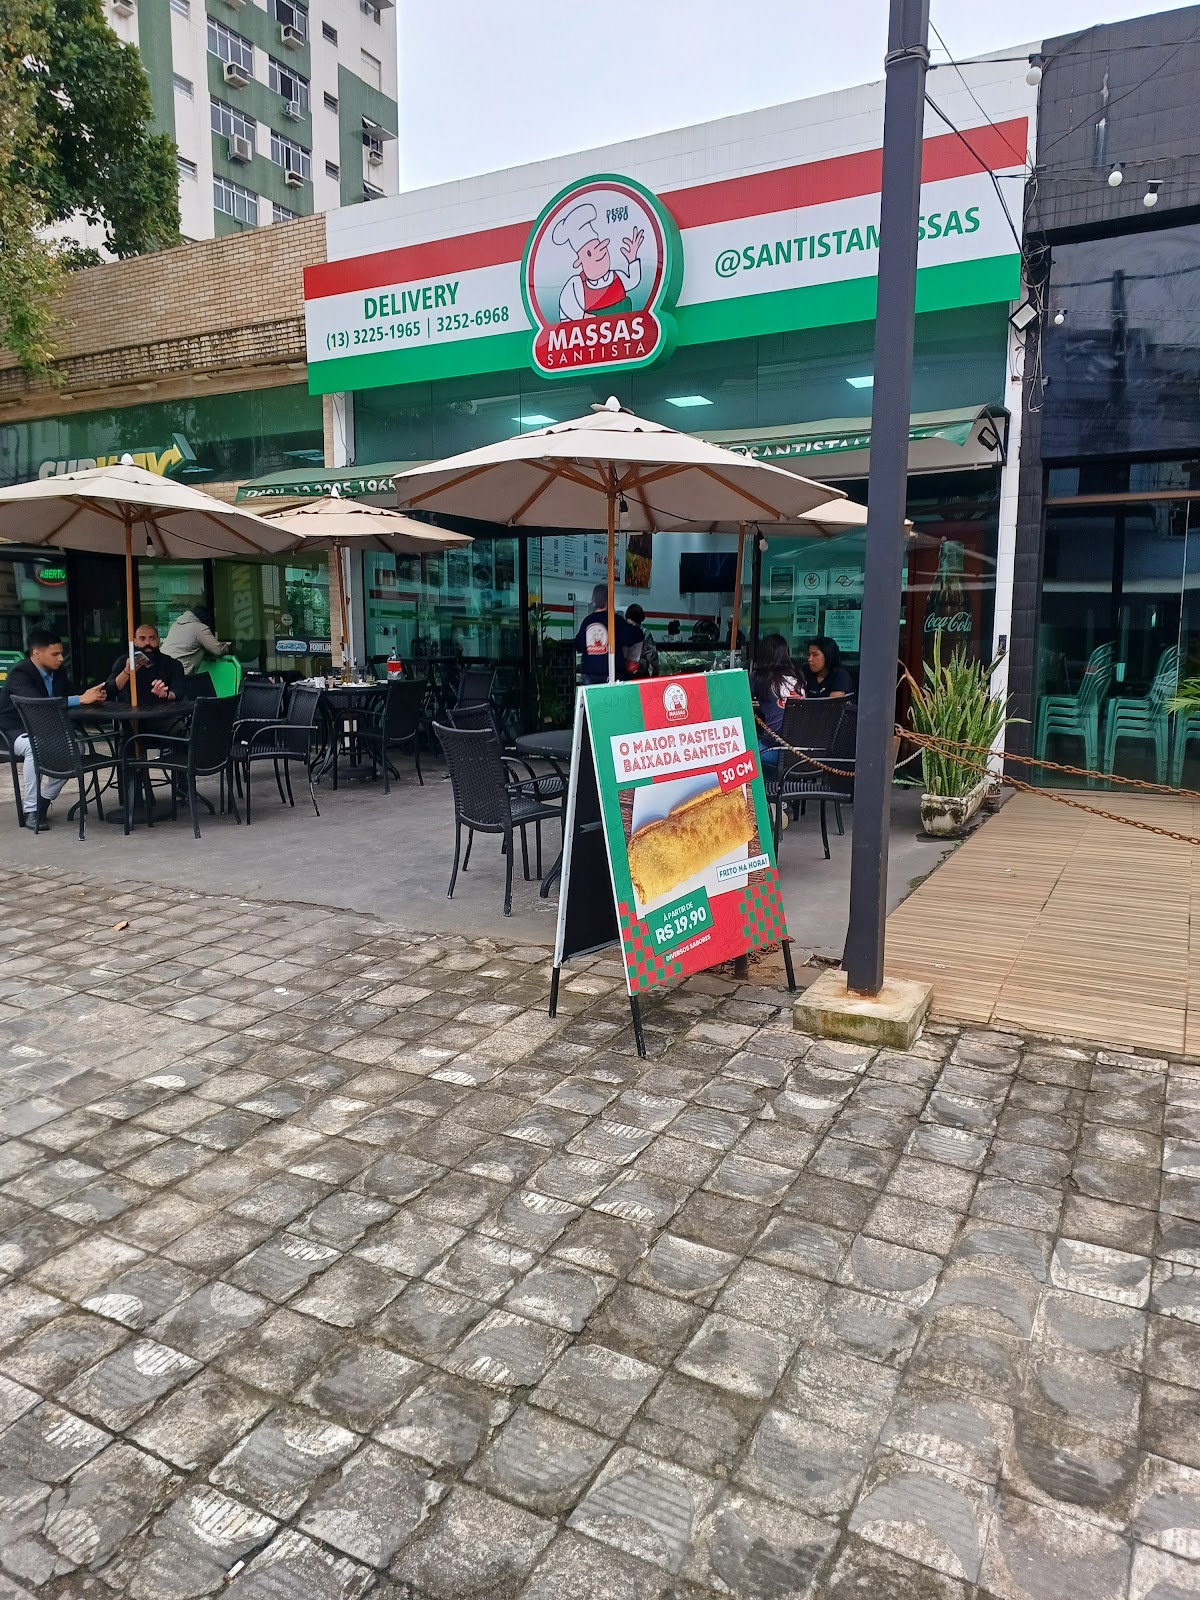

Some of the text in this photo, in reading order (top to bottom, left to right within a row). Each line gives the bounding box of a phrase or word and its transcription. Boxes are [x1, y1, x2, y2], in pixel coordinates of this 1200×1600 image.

[606, 213, 628, 224] 1990
[715, 206, 980, 278] @SANTISTAMSSAS
[364, 281, 459, 319] DELIVERY
[326, 331, 350, 351] (13)
[353, 320, 421, 345] 3225-1965
[436, 306, 510, 332] 3252-6968
[547, 317, 645, 351] MASSAS
[547, 342, 646, 366] SANTISTA
[39, 569, 66, 579] ABERTO
[619, 725, 739, 756] O MAIOR PASTEL DA
[623, 740, 740, 773] BAIXADA SANTISTA
[721, 759, 754, 783] 30 CM
[719, 857, 768, 878] FRITO NA HORA!
[668, 906, 686, 918] PARTIR
[685, 901, 694, 910] DE
[674, 906, 706, 935] 19,90
[665, 933, 712, 962] DIVERSOS SABORES
